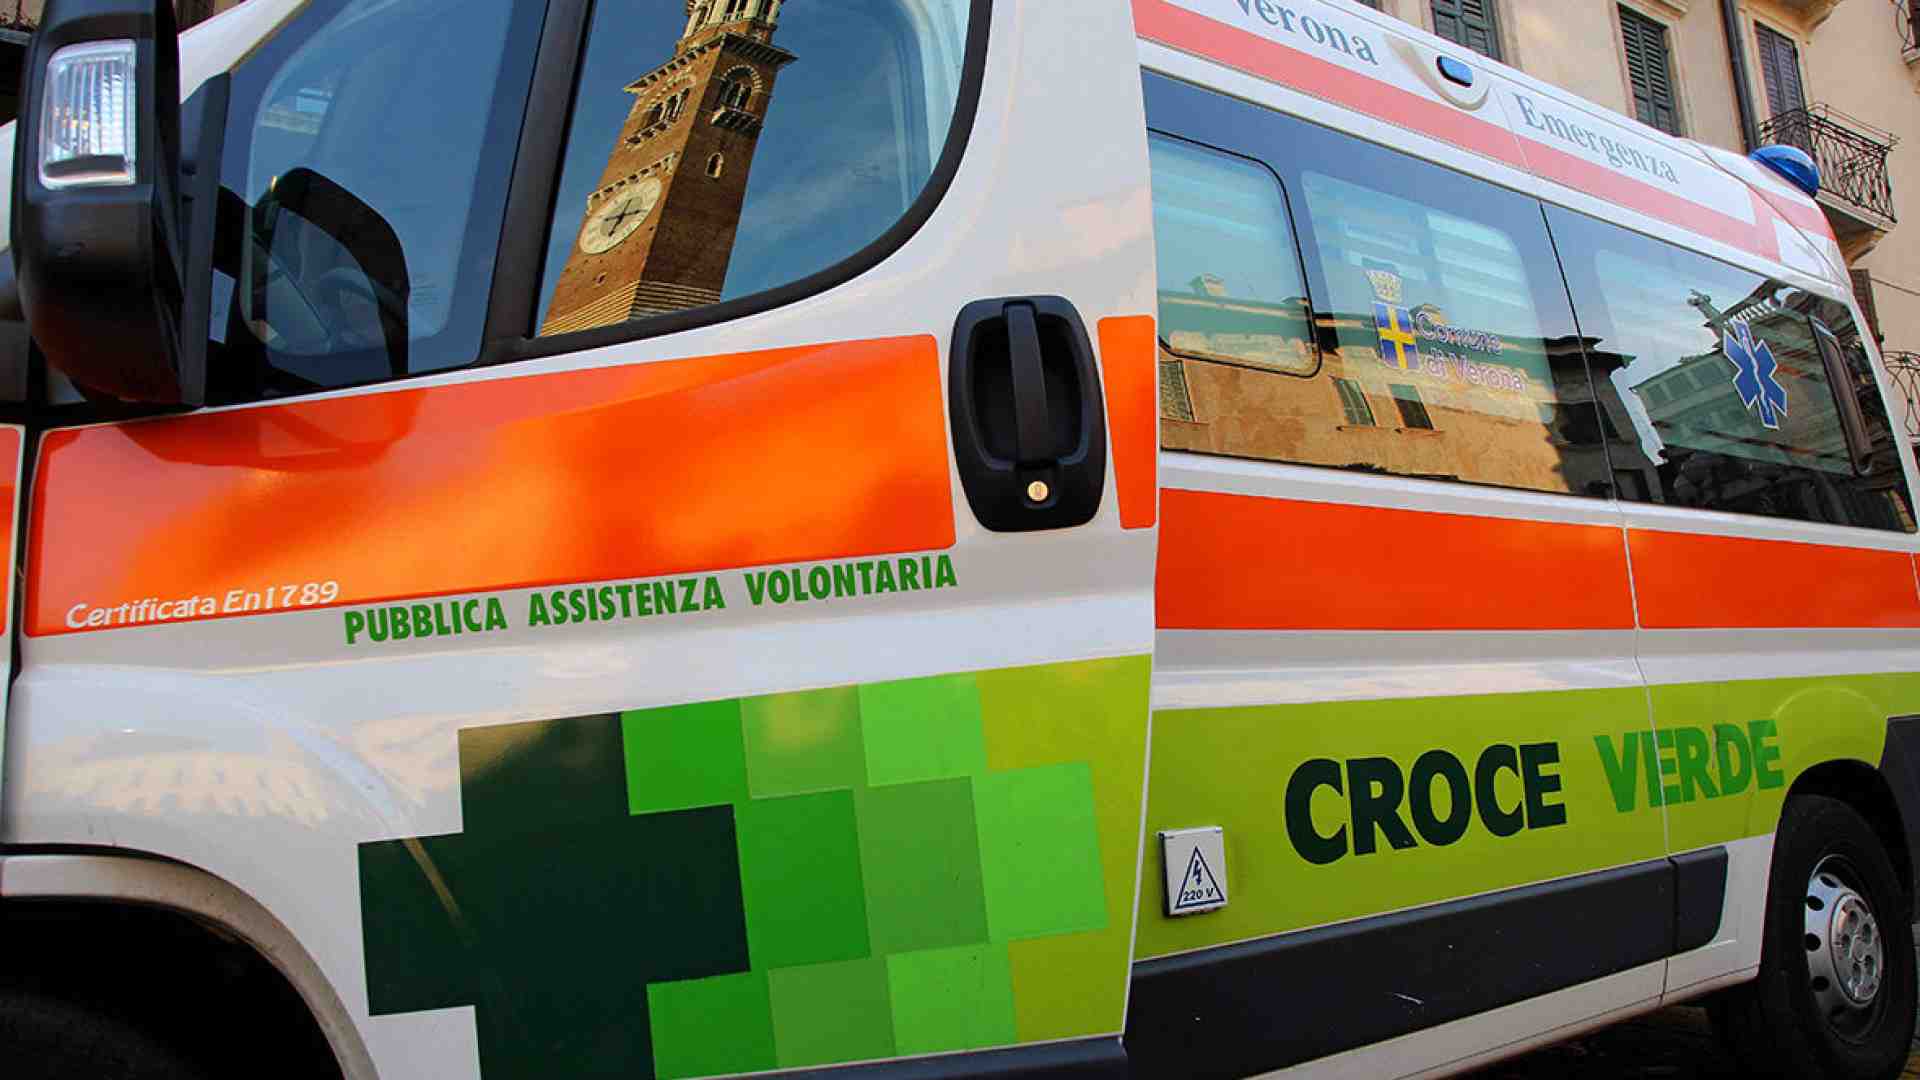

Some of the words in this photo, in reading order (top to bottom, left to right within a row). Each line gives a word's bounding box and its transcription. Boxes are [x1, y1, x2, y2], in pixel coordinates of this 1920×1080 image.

[1511, 91, 1681, 185] Emergenza
[1415, 309, 1503, 355] Comune
[1424, 347, 1448, 377] di
[1450, 352, 1527, 393] Verona
[64, 595, 215, 629] Certificata
[222, 580, 340, 614] En1789
[344, 597, 508, 645] PUBBLICA
[527, 575, 727, 627] ASSISTENZA
[743, 554, 958, 605] VOLONTARIA
[1284, 741, 1567, 865] CROCE
[1593, 719, 1786, 813] VERDE
[1183, 888, 1204, 902] 220
[1205, 887, 1215, 897] V
